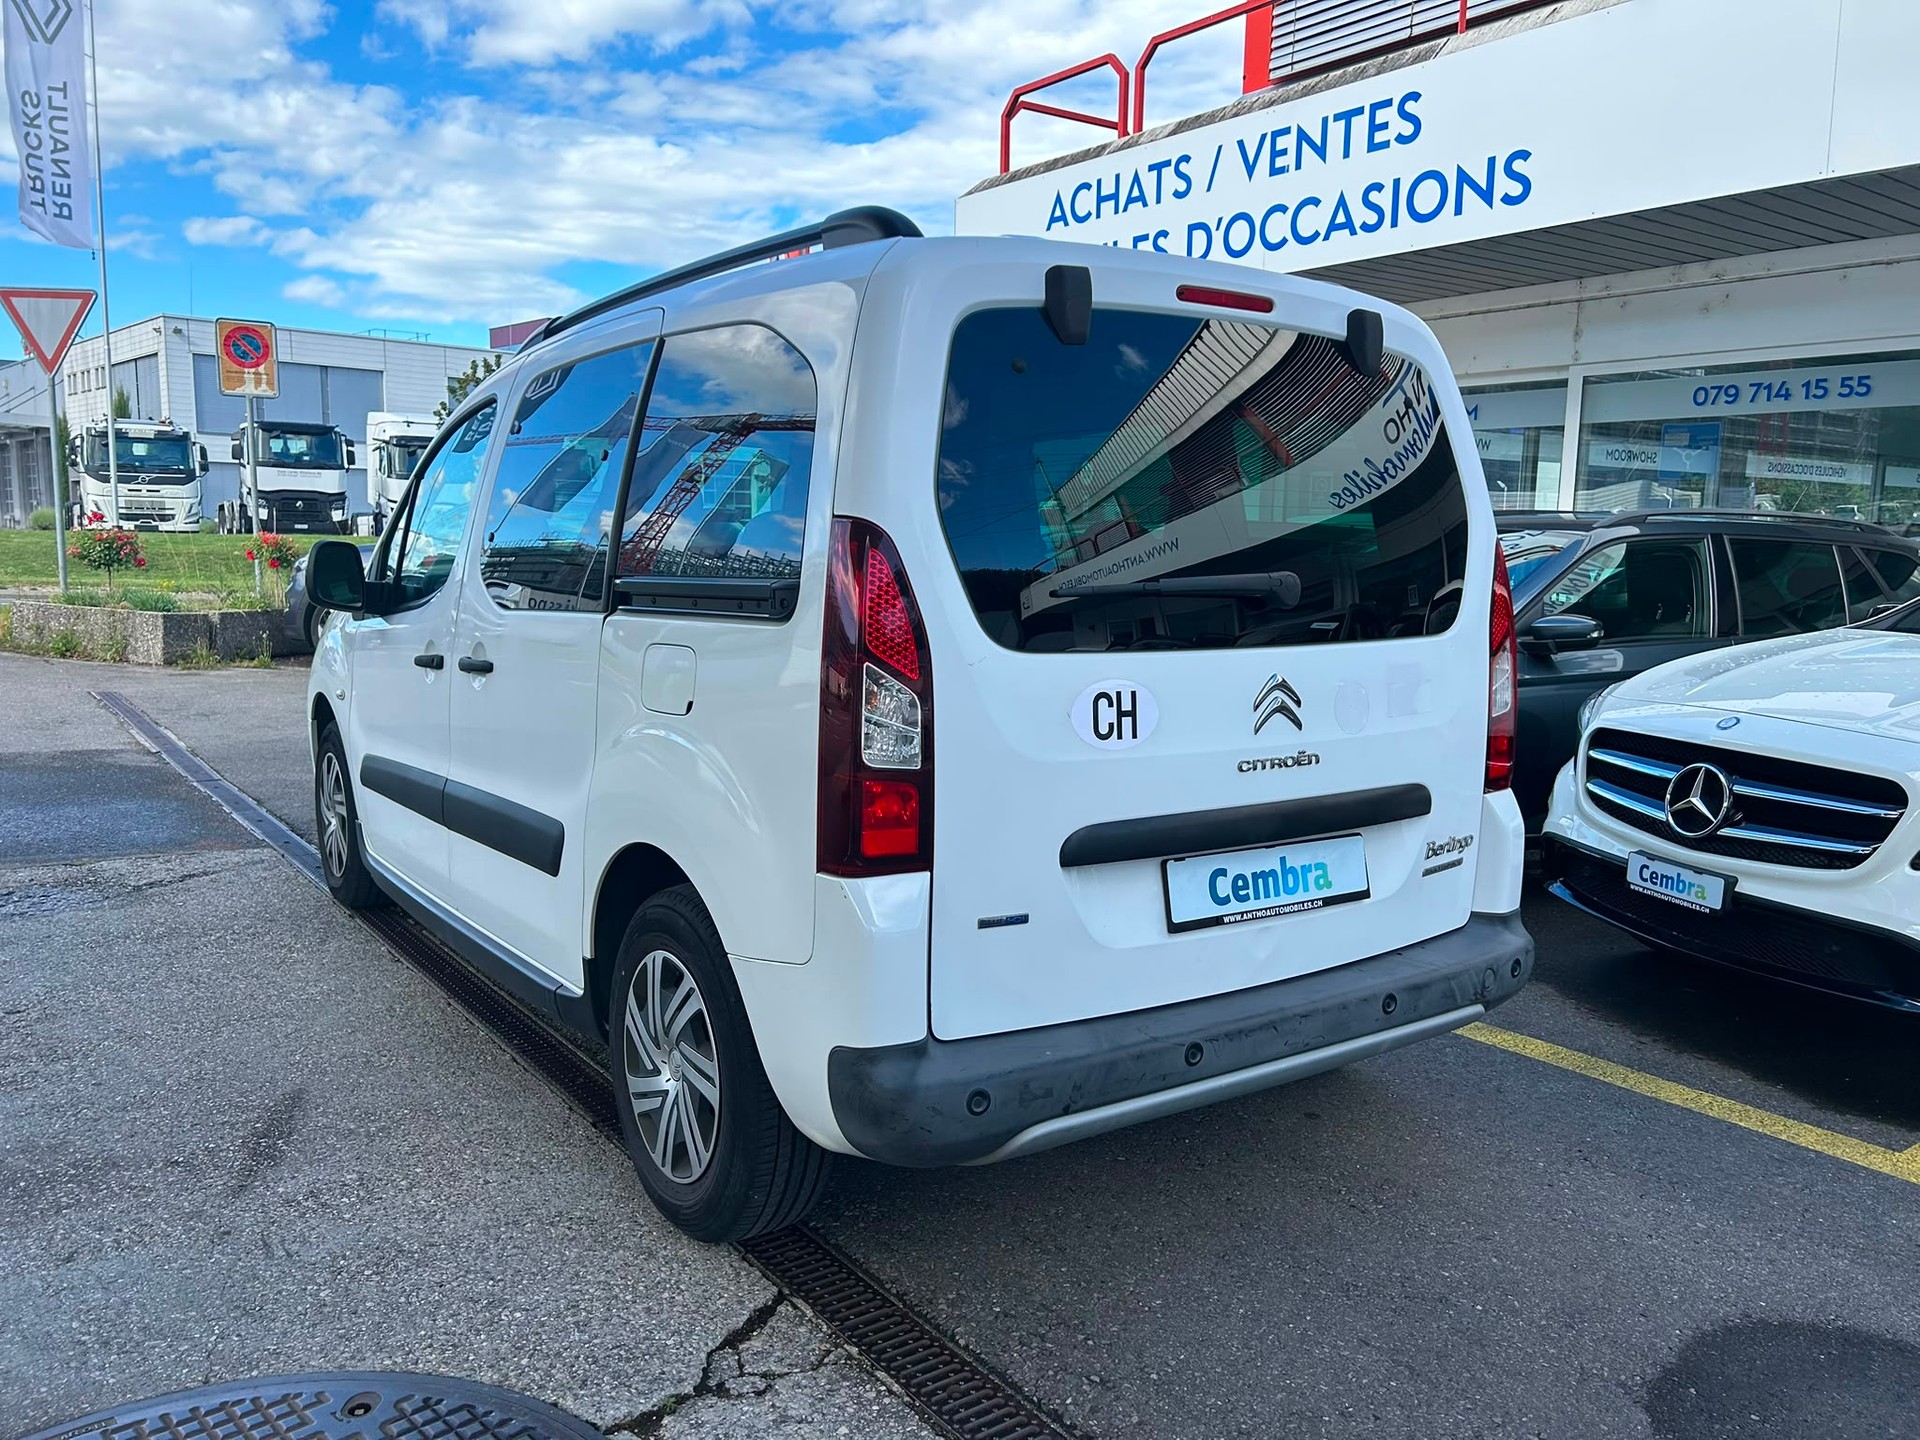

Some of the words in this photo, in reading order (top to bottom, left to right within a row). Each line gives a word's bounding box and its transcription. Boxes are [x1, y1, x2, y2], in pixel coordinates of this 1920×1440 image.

[1045, 153, 1193, 232] ACHATS
[1236, 90, 1423, 183] VENTES
[1186, 149, 1533, 260] D'OCCASIONS
[1692, 384, 1740, 407] 079
[1749, 380, 1792, 403] 714
[1801, 377, 1829, 400] 15
[1837, 375, 1872, 398] 55
[1092, 690, 1138, 741] CH
[1424, 834, 1474, 861] Berlingo
[1208, 855, 1333, 907] Cembra
[1629, 884, 1710, 914] WWW.ANTHOAUTOMOBILES.CH
[1638, 863, 1707, 901] Cembra
[1223, 899, 1323, 924] WWW.ANTHOAUTOMOBILES.CH
